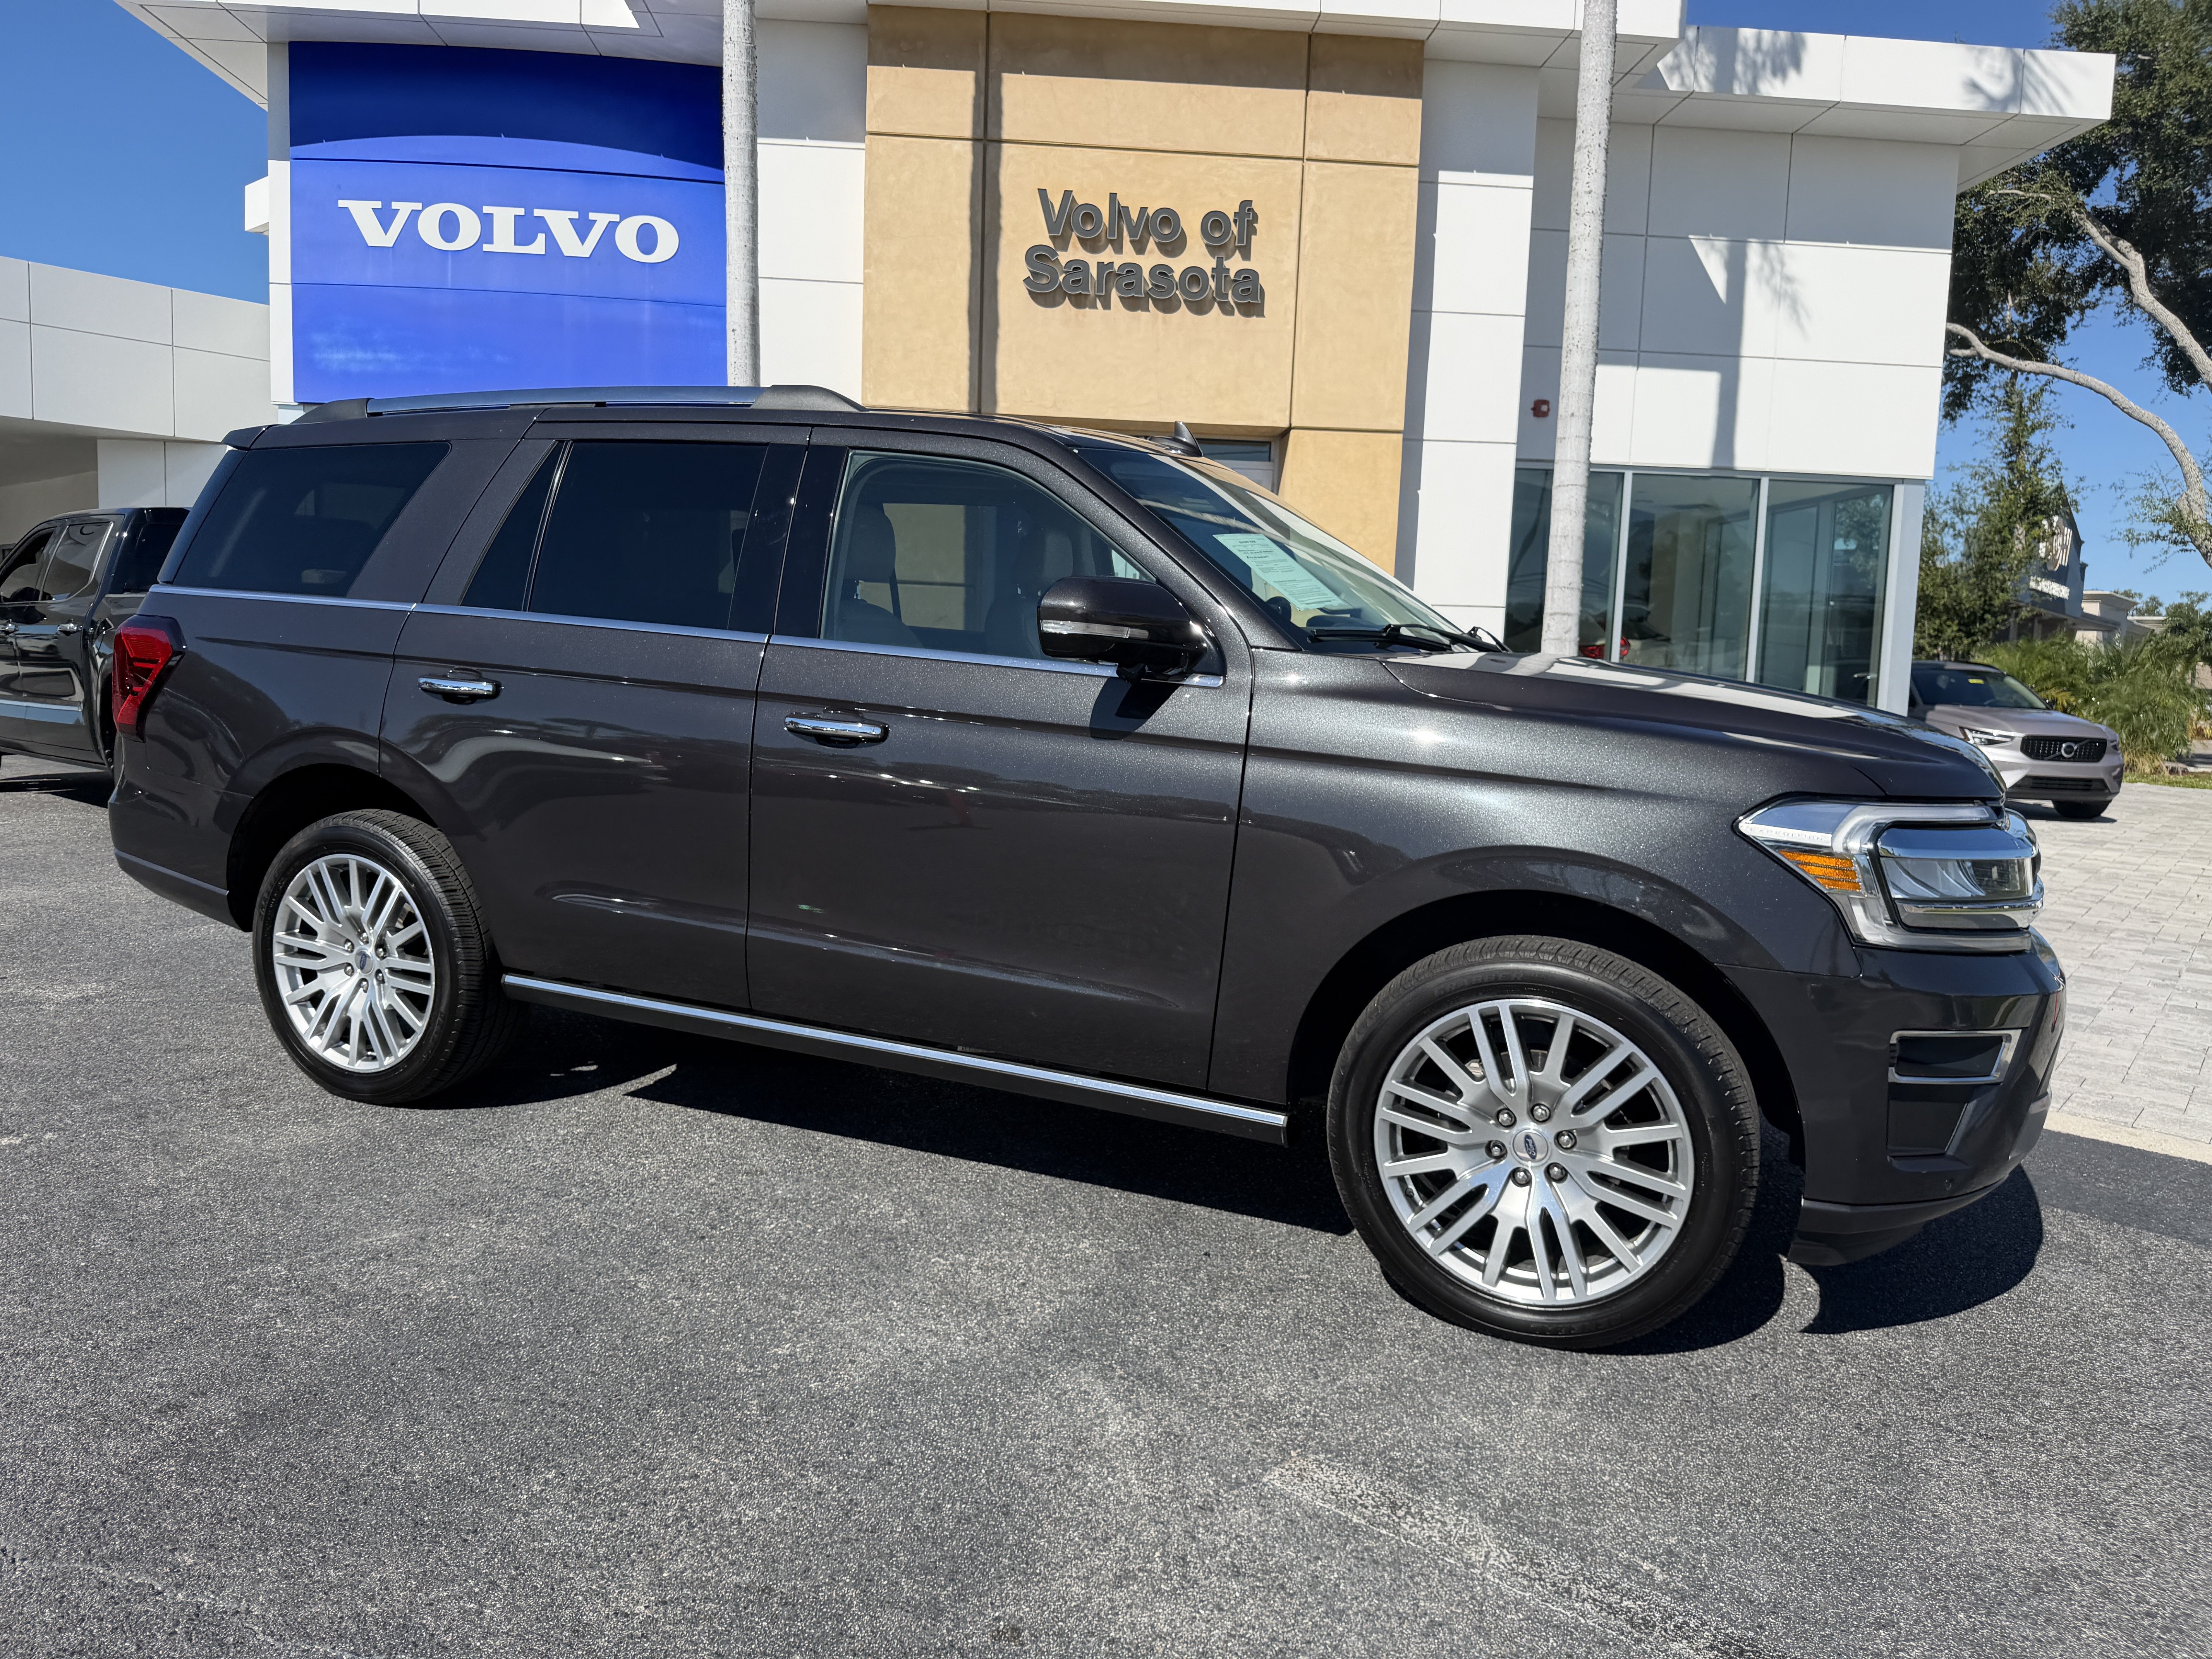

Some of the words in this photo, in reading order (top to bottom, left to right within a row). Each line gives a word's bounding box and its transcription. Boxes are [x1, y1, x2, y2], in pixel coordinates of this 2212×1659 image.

[338, 199, 679, 263] VOLVO
[1037, 188, 1182, 243] Volvo
[1200, 199, 1254, 246] of
[1022, 244, 1262, 303] Sarasota
